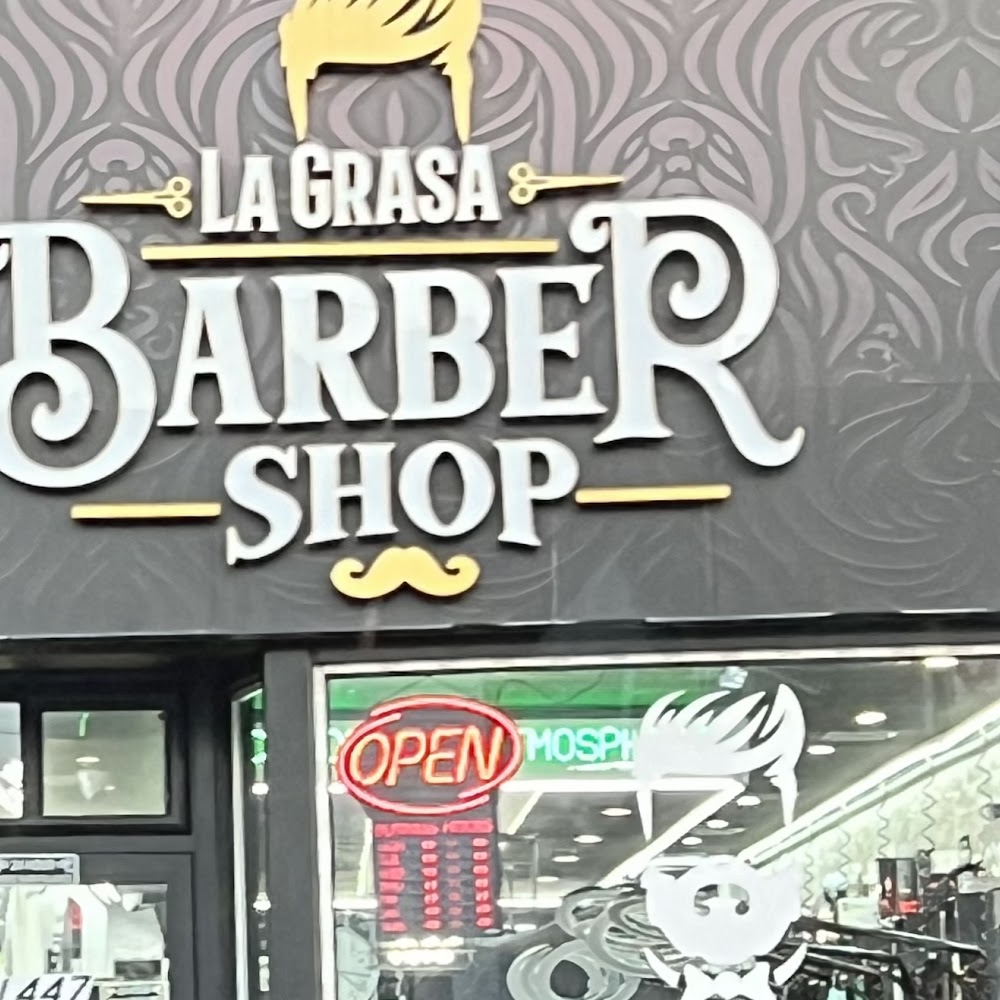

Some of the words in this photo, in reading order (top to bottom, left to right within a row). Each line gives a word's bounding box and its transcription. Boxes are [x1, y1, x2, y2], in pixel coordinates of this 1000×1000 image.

[199, 147, 280, 234] LA
[290, 140, 502, 230] GRASA
[223, 436, 580, 565] SHOP
[350, 724, 505, 786] OPEN
